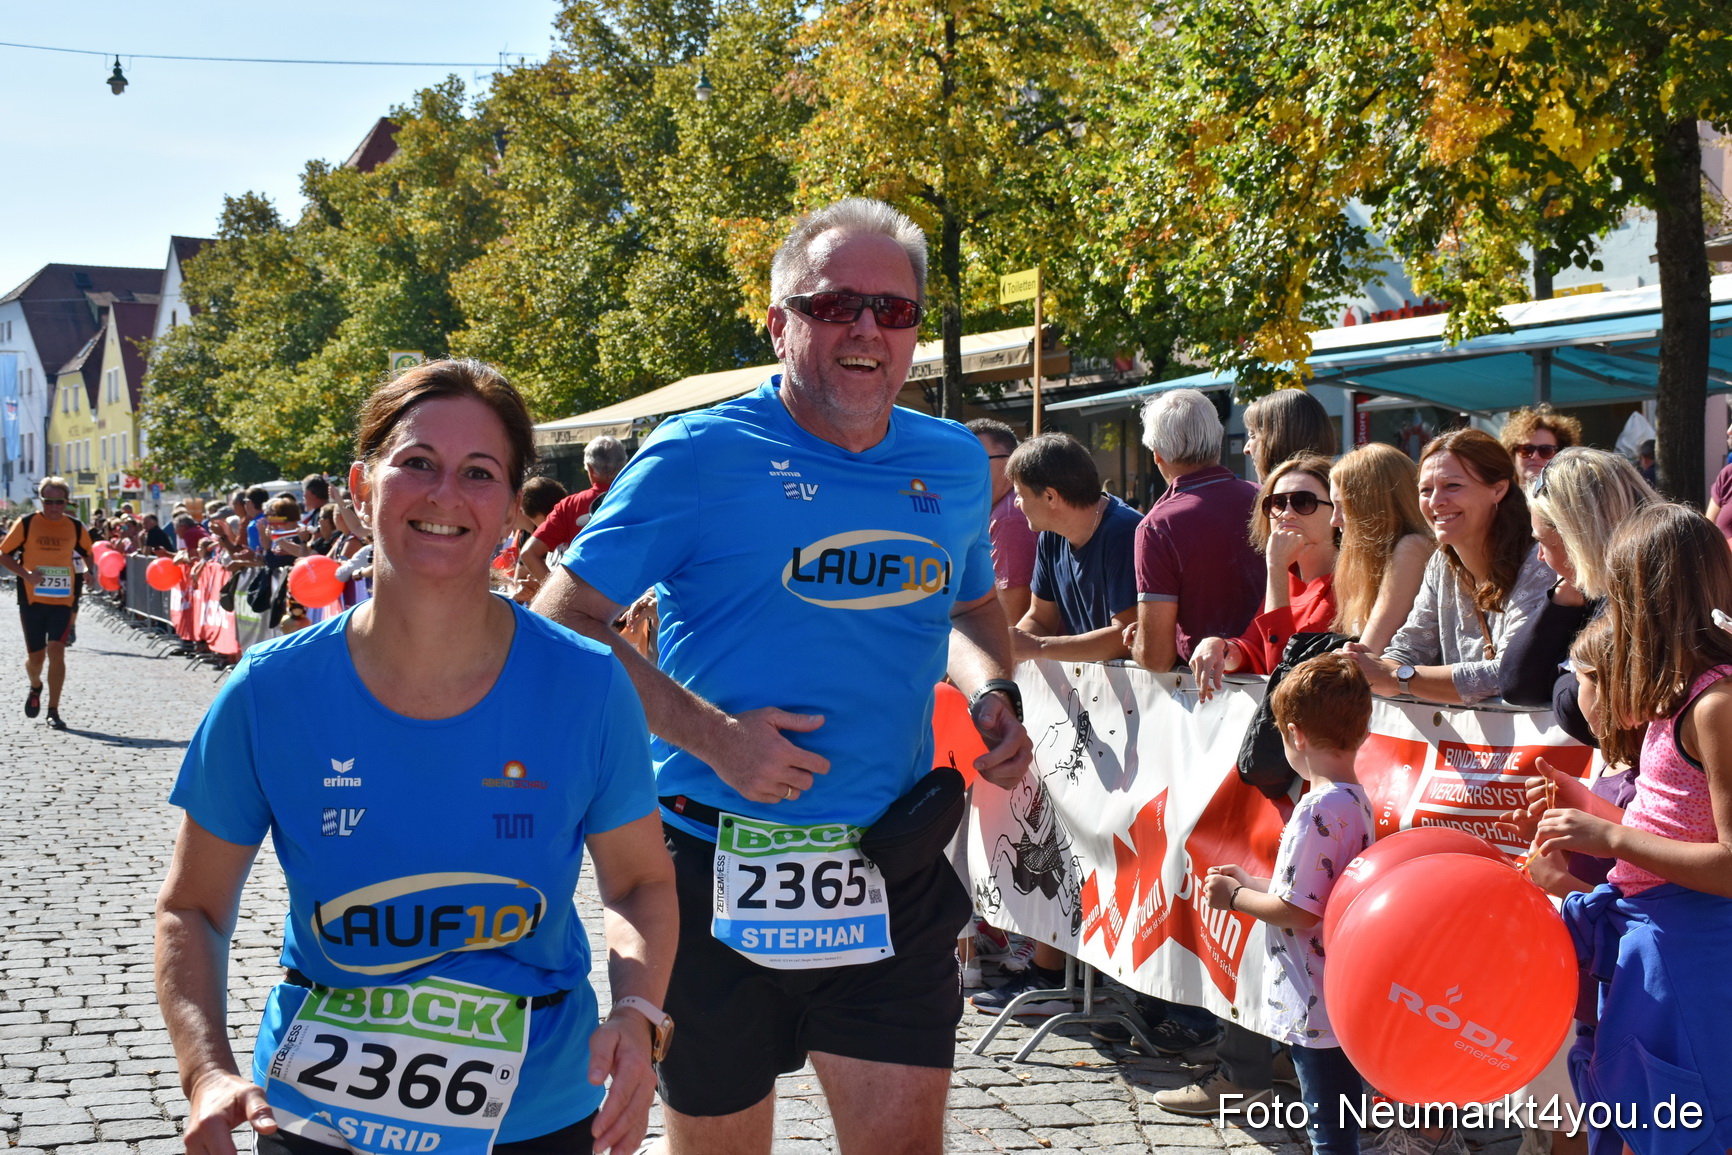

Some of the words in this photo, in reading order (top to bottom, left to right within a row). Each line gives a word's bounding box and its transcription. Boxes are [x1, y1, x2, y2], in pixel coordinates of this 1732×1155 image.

[1007, 279, 1036, 294] Toiletten
[909, 495, 941, 515] TUM
[39, 577, 67, 587] 2751
[791, 547, 950, 595] LAUF10!
[1445, 748, 1522, 771] BINDESTRICKE
[323, 775, 362, 788] erima
[481, 778, 547, 790] ABENDSCHAU
[1430, 783, 1529, 806] VERZURRSYST
[492, 813, 534, 839] TUM
[1379, 800, 1395, 826] Seit
[734, 823, 862, 852] BOC
[737, 859, 867, 909] 2365
[314, 900, 543, 948] LAUF10!
[741, 923, 865, 949] STEPHAN
[1212, 948, 1220, 961] ist
[318, 986, 508, 1040] BOCK
[1453, 1039, 1511, 1072] energie
[297, 1034, 495, 1116] 2366
